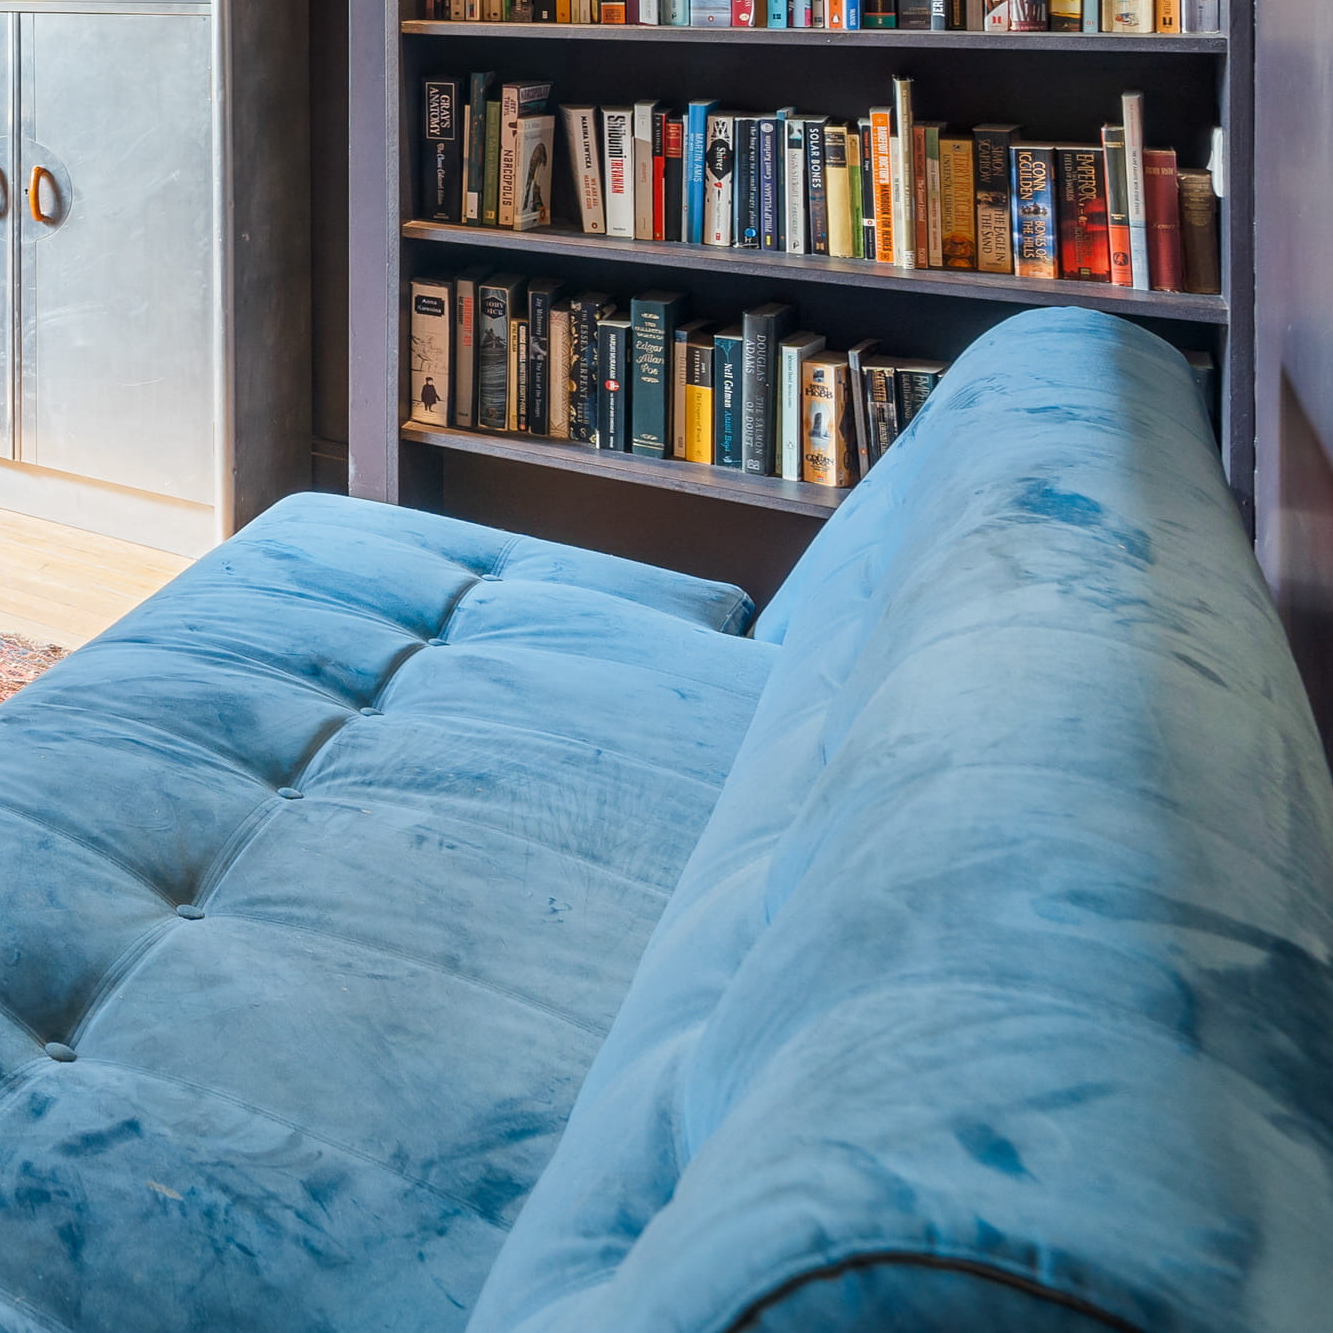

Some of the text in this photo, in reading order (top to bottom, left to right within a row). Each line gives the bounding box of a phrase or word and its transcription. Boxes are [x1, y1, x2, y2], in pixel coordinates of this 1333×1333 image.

[429, 87, 440, 135] ANATOMY
[440, 94, 450, 129] GRAY'S
[608, 115, 627, 159] Shibumi
[611, 159, 624, 194] TREVANIAN
[694, 133, 703, 182] MARTIN AMIS
[716, 147, 726, 171] Shiver
[809, 128, 821, 188] SOLAR BONES
[1018, 152, 1033, 201] IGGULDEN
[1032, 161, 1046, 191] CONN
[1076, 154, 1097, 201] EMPEROR
[981, 213, 992, 254] THE SAND
[993, 209, 1006, 262] THE EAGLE IN
[1023, 221, 1034, 259] THE HILLS
[1035, 220, 1046, 259] BONES OF
[636, 341, 663, 351] Edgar
[636, 355, 664, 364] Allan
[746, 339, 754, 374] ADAMS
[757, 335, 765, 382] DOUGLAS
[641, 364, 658, 375] Poe
[805, 388, 832, 398] HOBB
